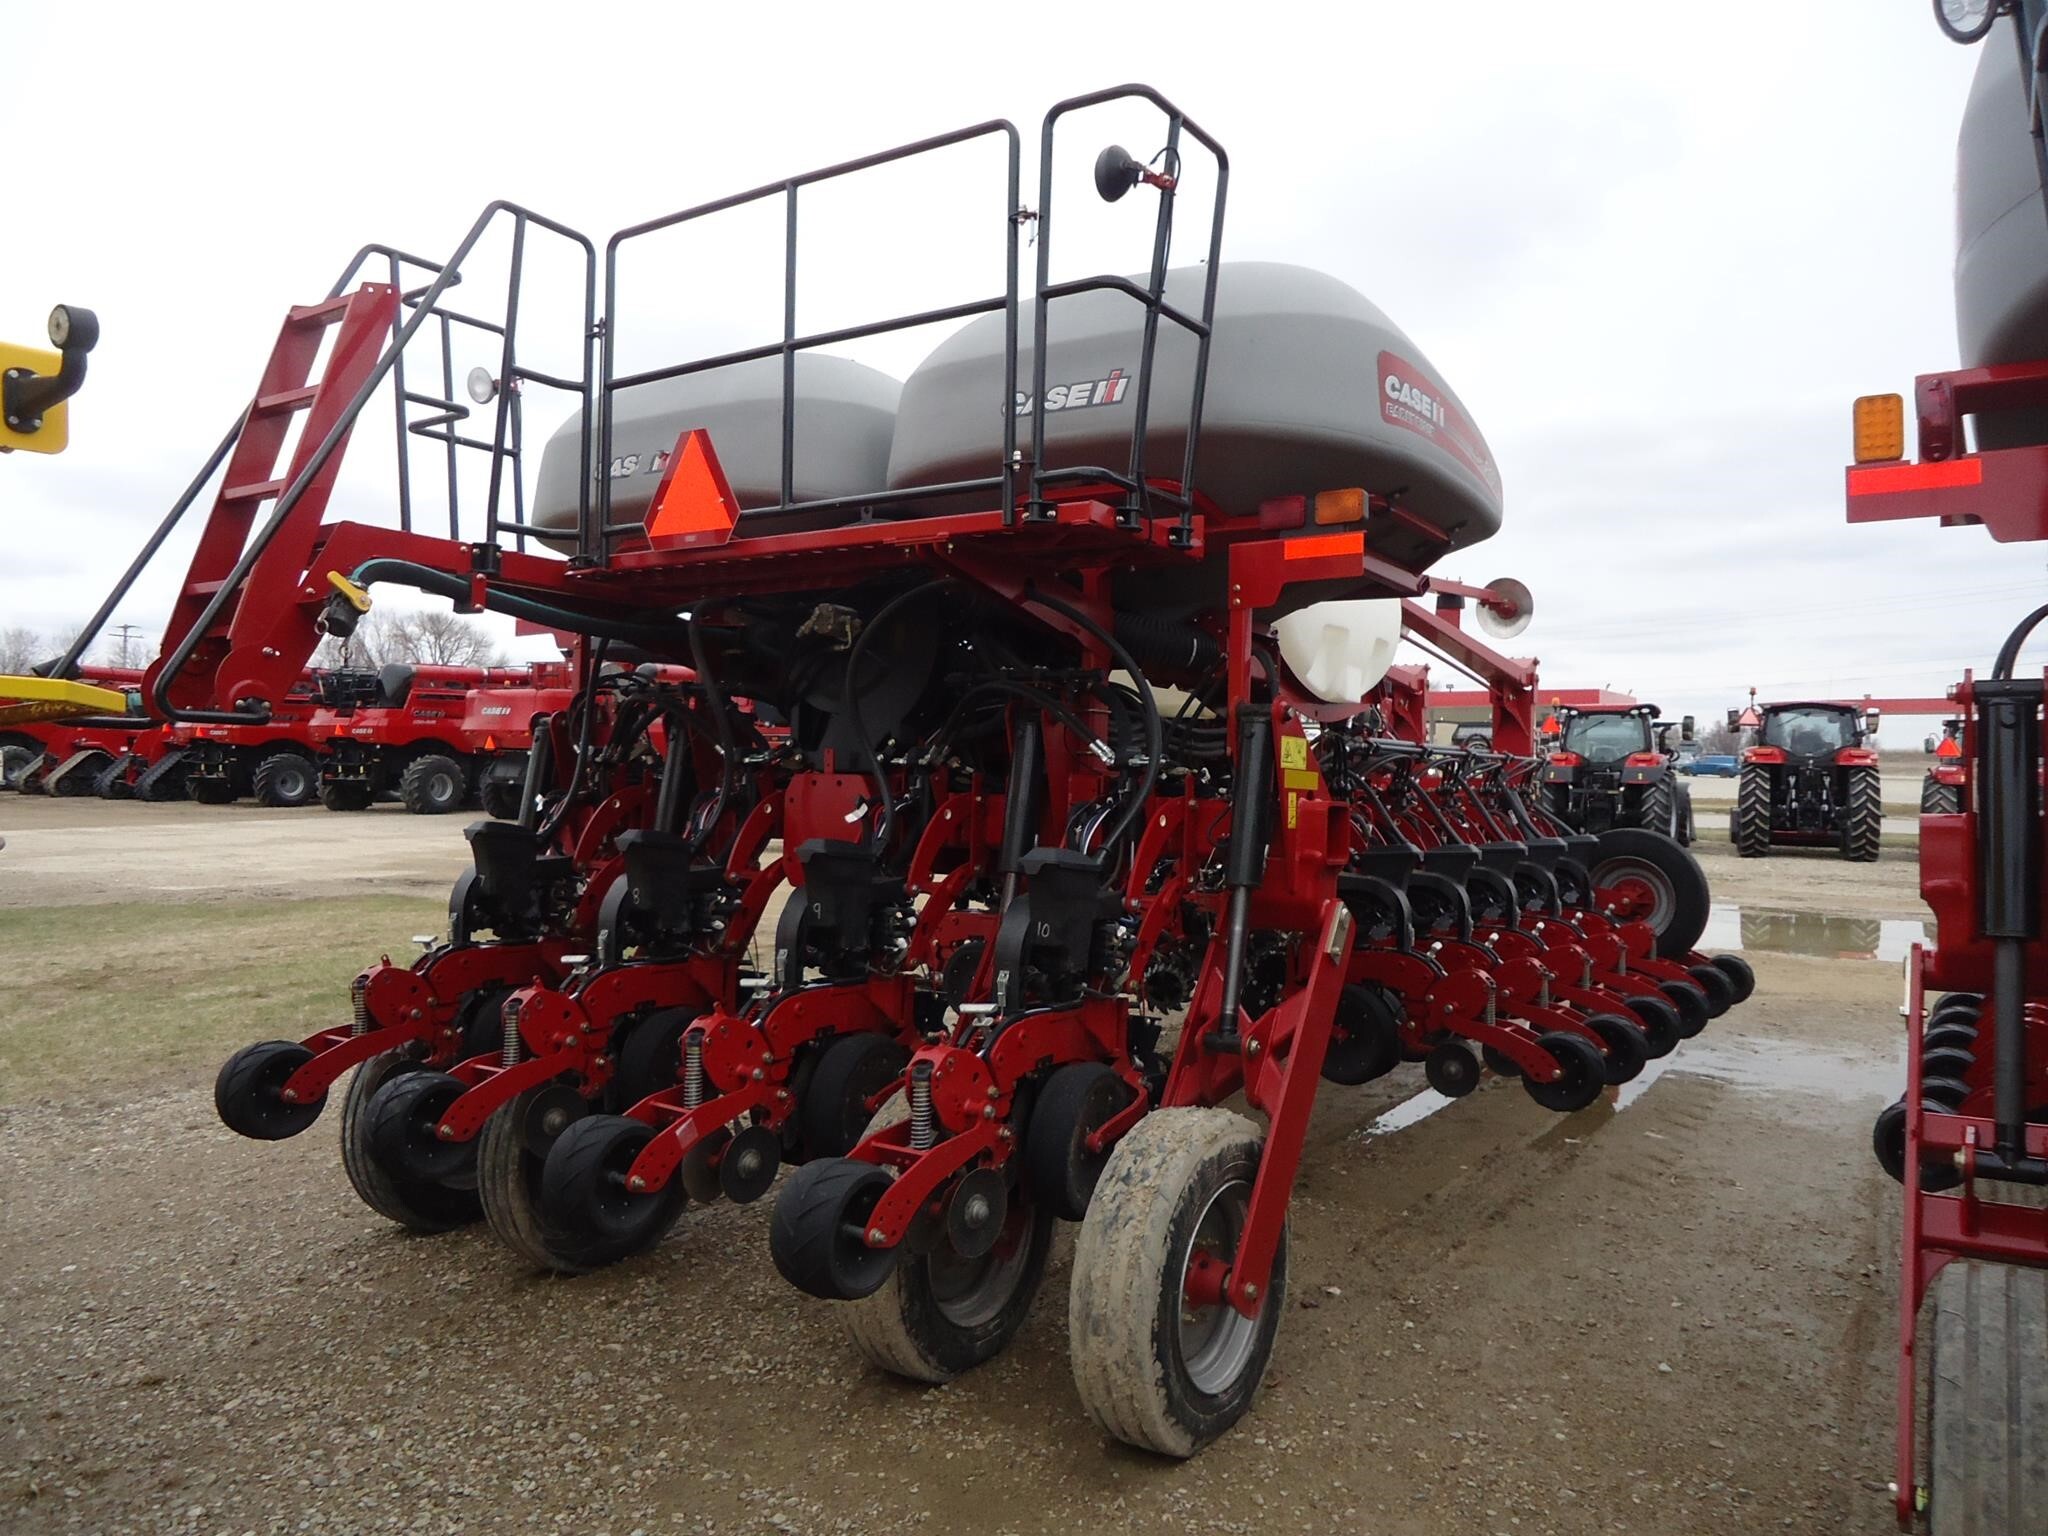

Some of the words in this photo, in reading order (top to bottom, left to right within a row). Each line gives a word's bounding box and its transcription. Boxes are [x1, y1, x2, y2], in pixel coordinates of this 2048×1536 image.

[1384, 374, 1432, 419] CASE
[632, 887, 640, 905] 8
[813, 902, 822, 920] 9
[1037, 921, 1050, 938] 10
